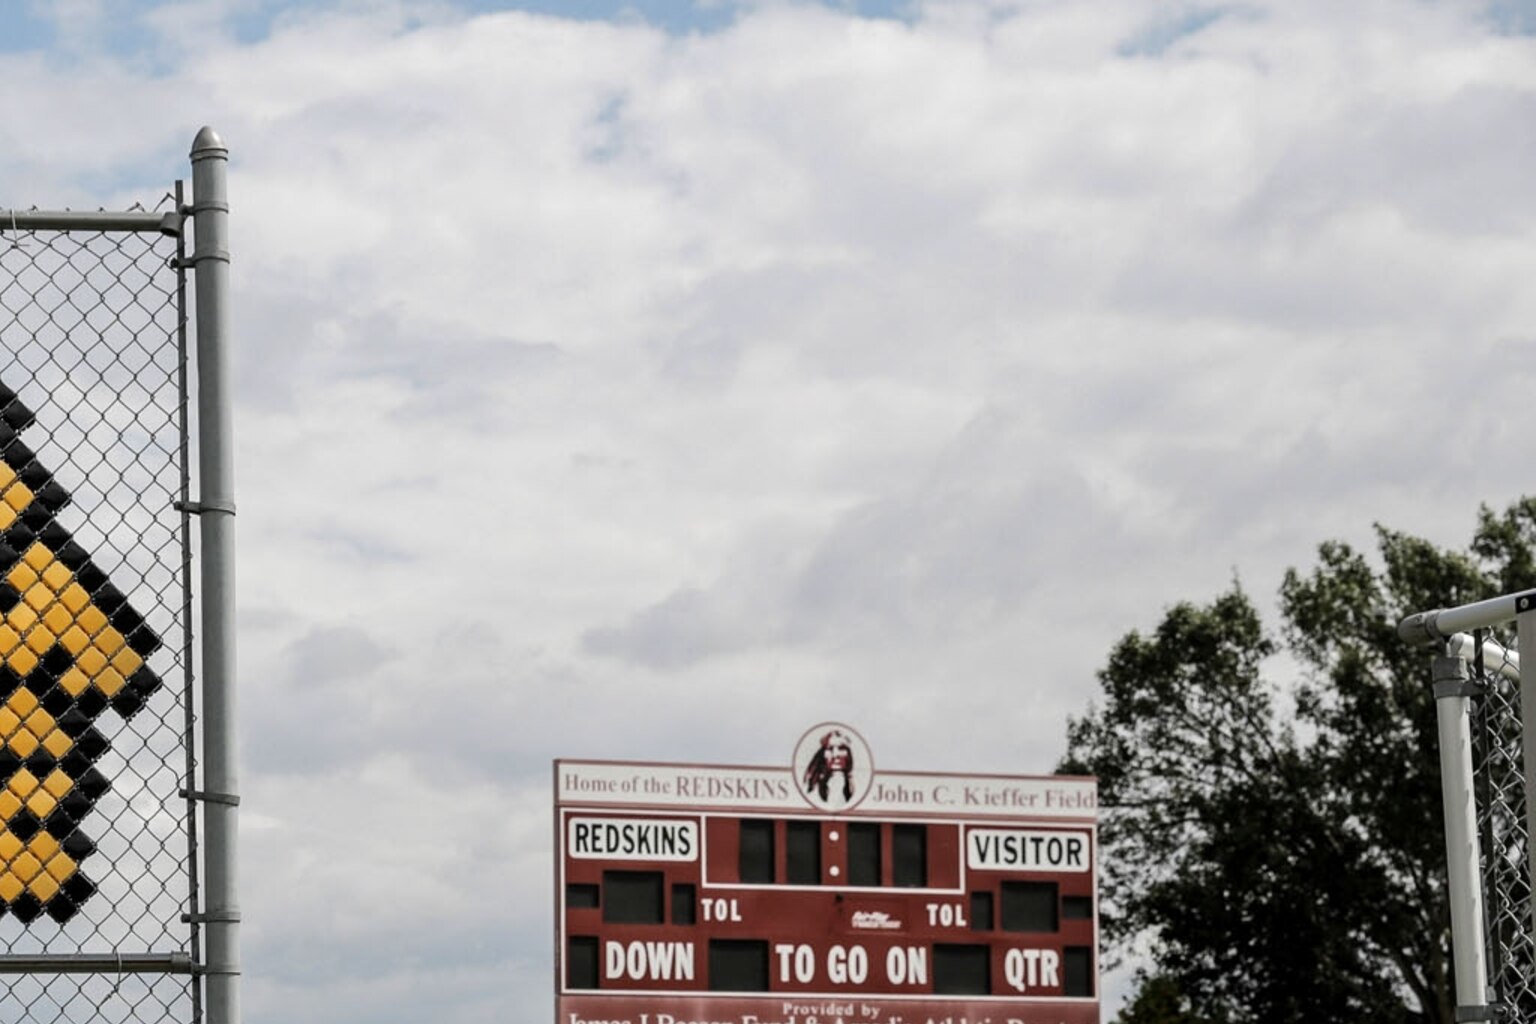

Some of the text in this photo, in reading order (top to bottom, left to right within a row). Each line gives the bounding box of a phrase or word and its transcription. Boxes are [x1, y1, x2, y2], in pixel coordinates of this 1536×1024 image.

[565, 773, 789, 799] Home of the REDSKINS
[873, 784, 1096, 808] John C. Kieffer Field
[575, 823, 691, 855] REDSKINS
[974, 835, 1082, 865] VISITOR
[701, 898, 742, 921] TOL
[926, 903, 966, 926] TOL
[605, 940, 694, 980] DOWN
[775, 944, 868, 984] TO GO
[886, 946, 927, 985] ON
[1004, 948, 1059, 992] QTR
[782, 1003, 881, 1019] Provided by
